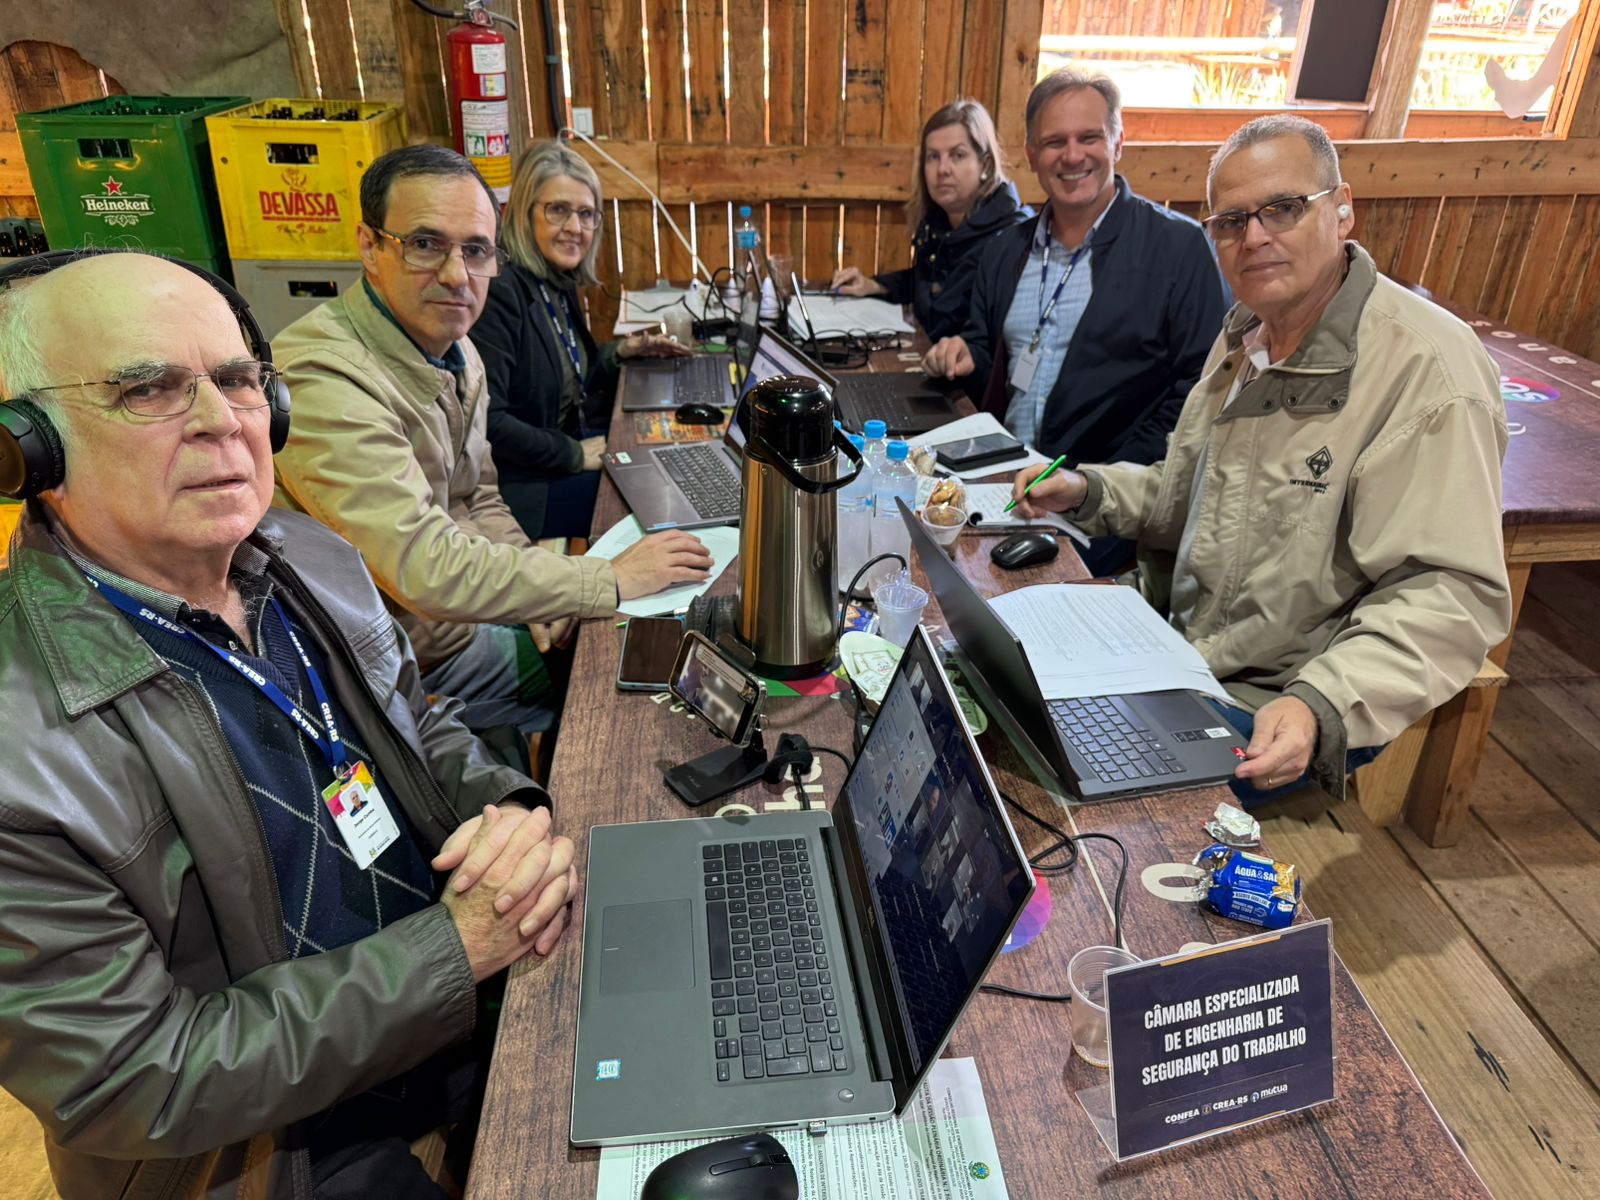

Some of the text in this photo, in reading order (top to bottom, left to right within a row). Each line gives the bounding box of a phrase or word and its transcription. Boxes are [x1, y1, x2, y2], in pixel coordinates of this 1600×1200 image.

[85, 198, 150, 212] Heineken
[259, 190, 340, 217] DEVASSA
[320, 702, 340, 742] CREA-RS
[1144, 974, 1300, 1030] CÂMARA ESPECIALIZADA
[1164, 1005, 1284, 1053] DE ENGENHARIA DE
[1141, 1027, 1307, 1086] SEGURANÇA DO TRABALHO
[1165, 1108, 1200, 1124] CONFEA
[1213, 1095, 1248, 1111] CREA-RS
[931, 1124, 941, 1150] PLENÁRIA
[936, 1150, 947, 1180] ORDINÁRIA
